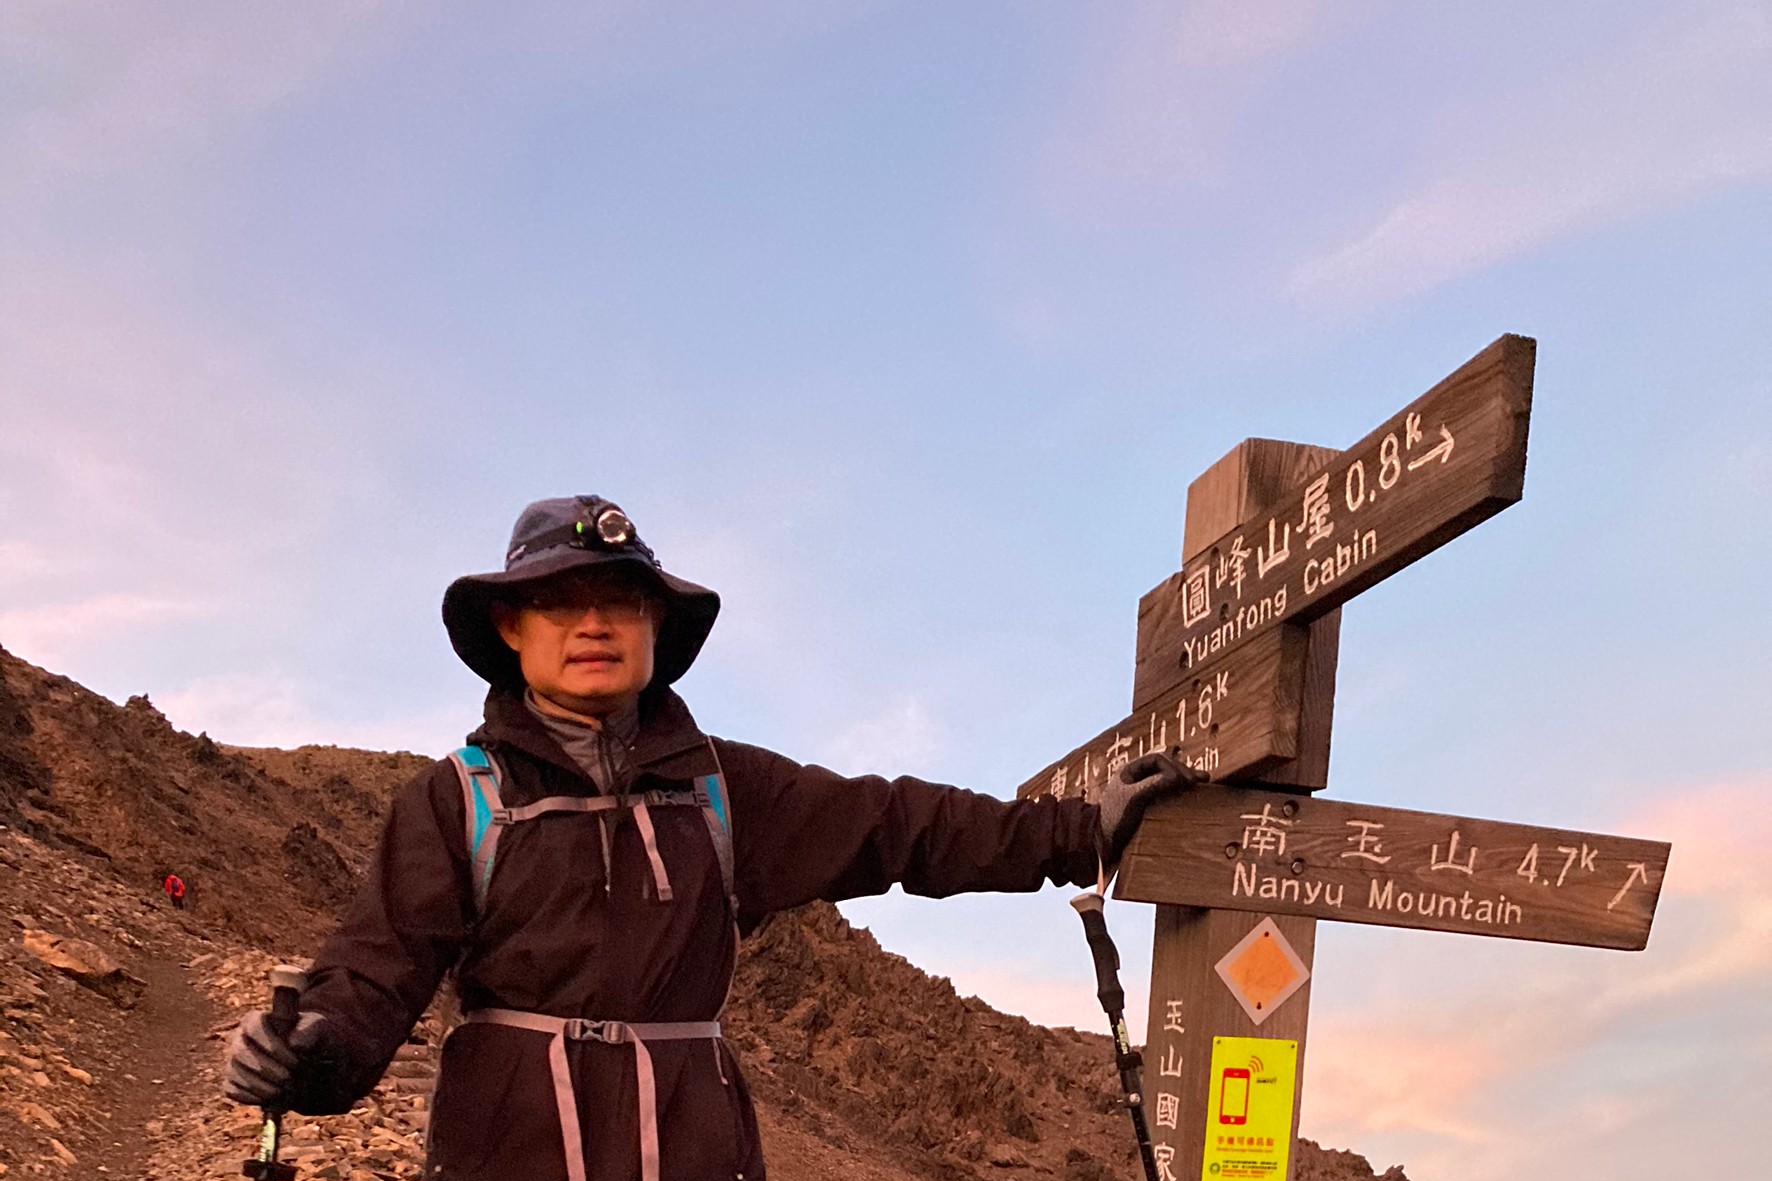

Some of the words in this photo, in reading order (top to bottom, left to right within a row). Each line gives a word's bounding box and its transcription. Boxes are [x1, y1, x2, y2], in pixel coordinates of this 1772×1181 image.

[1182, 472, 1334, 629] 圓峰山屋
[1184, 584, 1287, 668] Yuanfong
[1304, 529, 1377, 594] Cabin
[1240, 803, 1477, 874] 南玉山
[1232, 863, 1343, 907] Nanyu
[1369, 878, 1522, 924] Mountain
